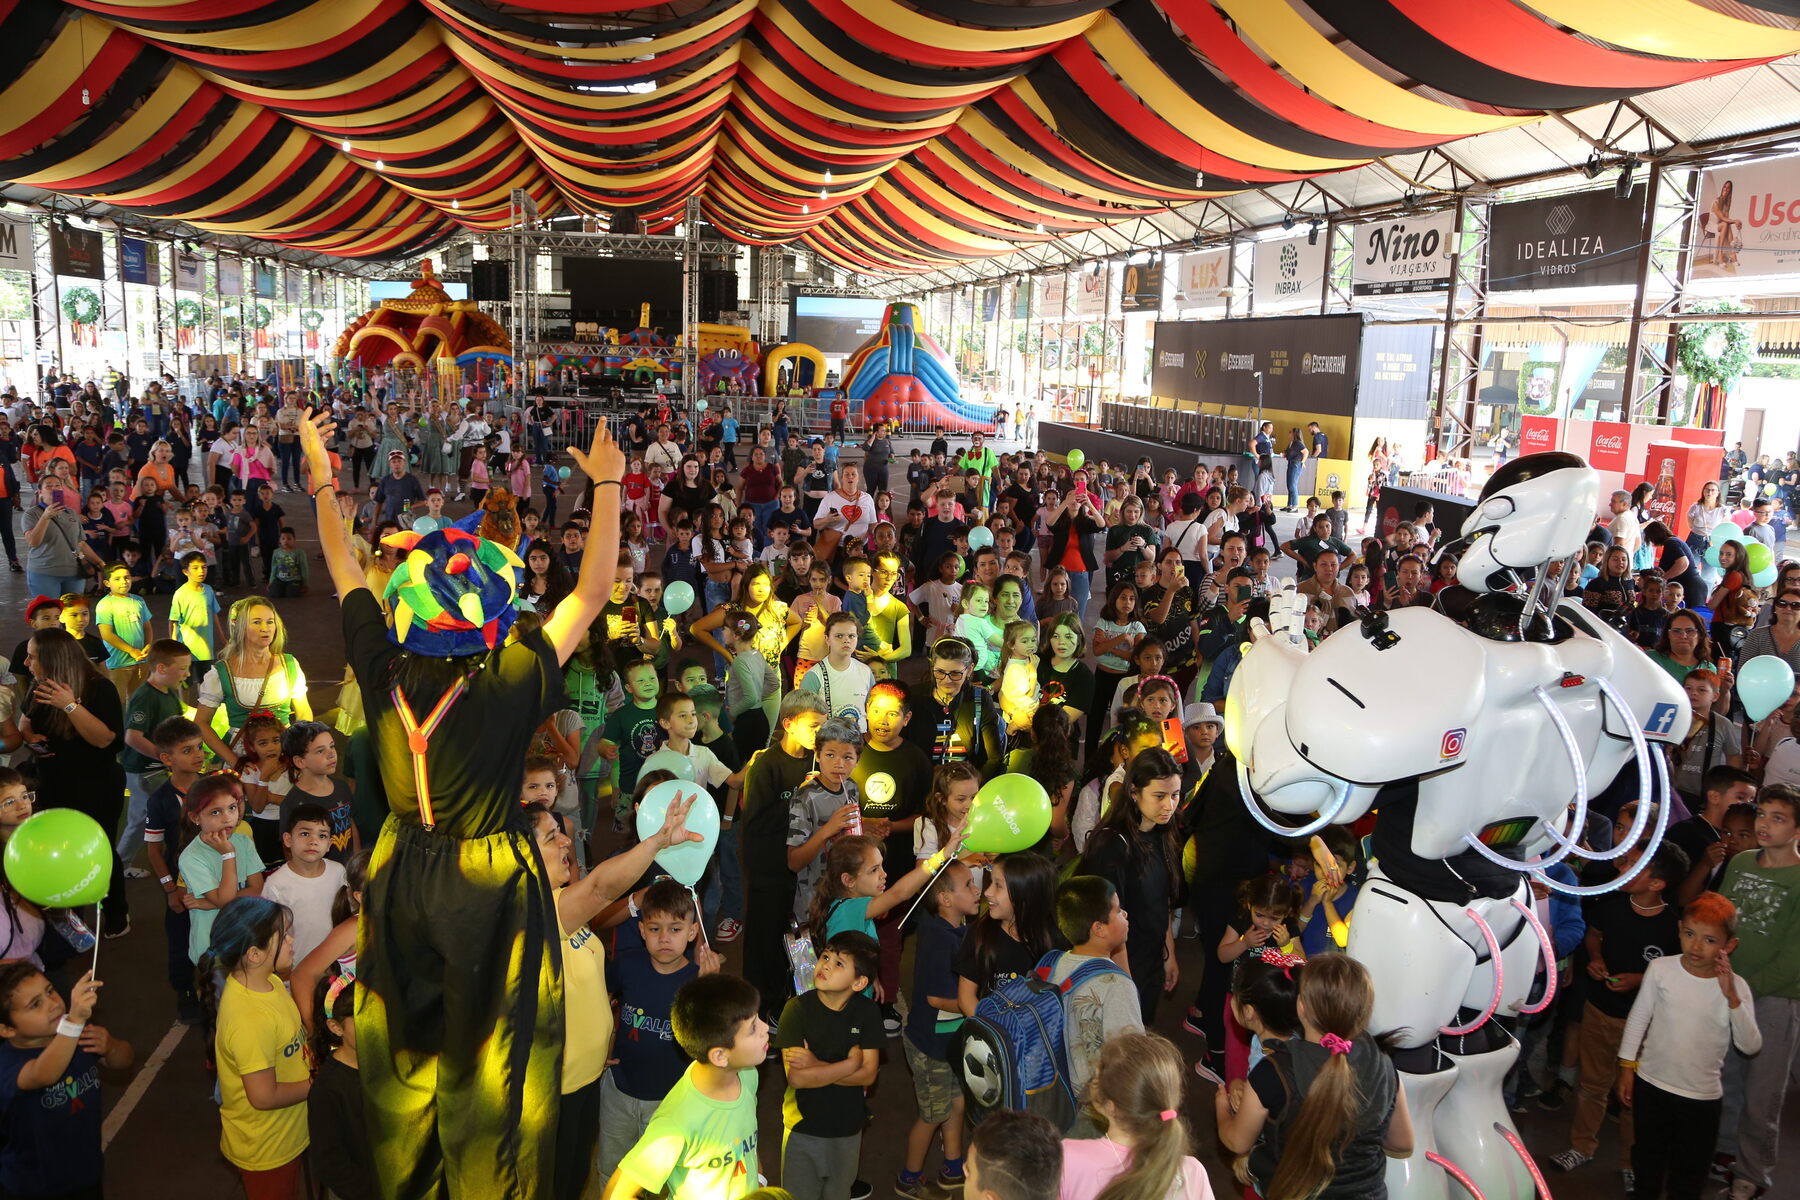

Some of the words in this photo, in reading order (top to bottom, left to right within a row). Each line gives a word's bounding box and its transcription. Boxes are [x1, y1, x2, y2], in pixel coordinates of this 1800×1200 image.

[1366, 224, 1440, 265] Nino
[1517, 235, 1604, 260] IDEALIZA
[1191, 256, 1223, 289] LUX
[1390, 261, 1437, 277] VIAGENS
[1540, 264, 1577, 275] VIDROS
[1275, 280, 1302, 295] INBRAX
[1227, 353, 1255, 371] EISENBAHN
[1311, 354, 1347, 375] EISENBAHN
[1595, 435, 1623, 449] Coca-Cola
[62, 863, 102, 899] SICOOB
